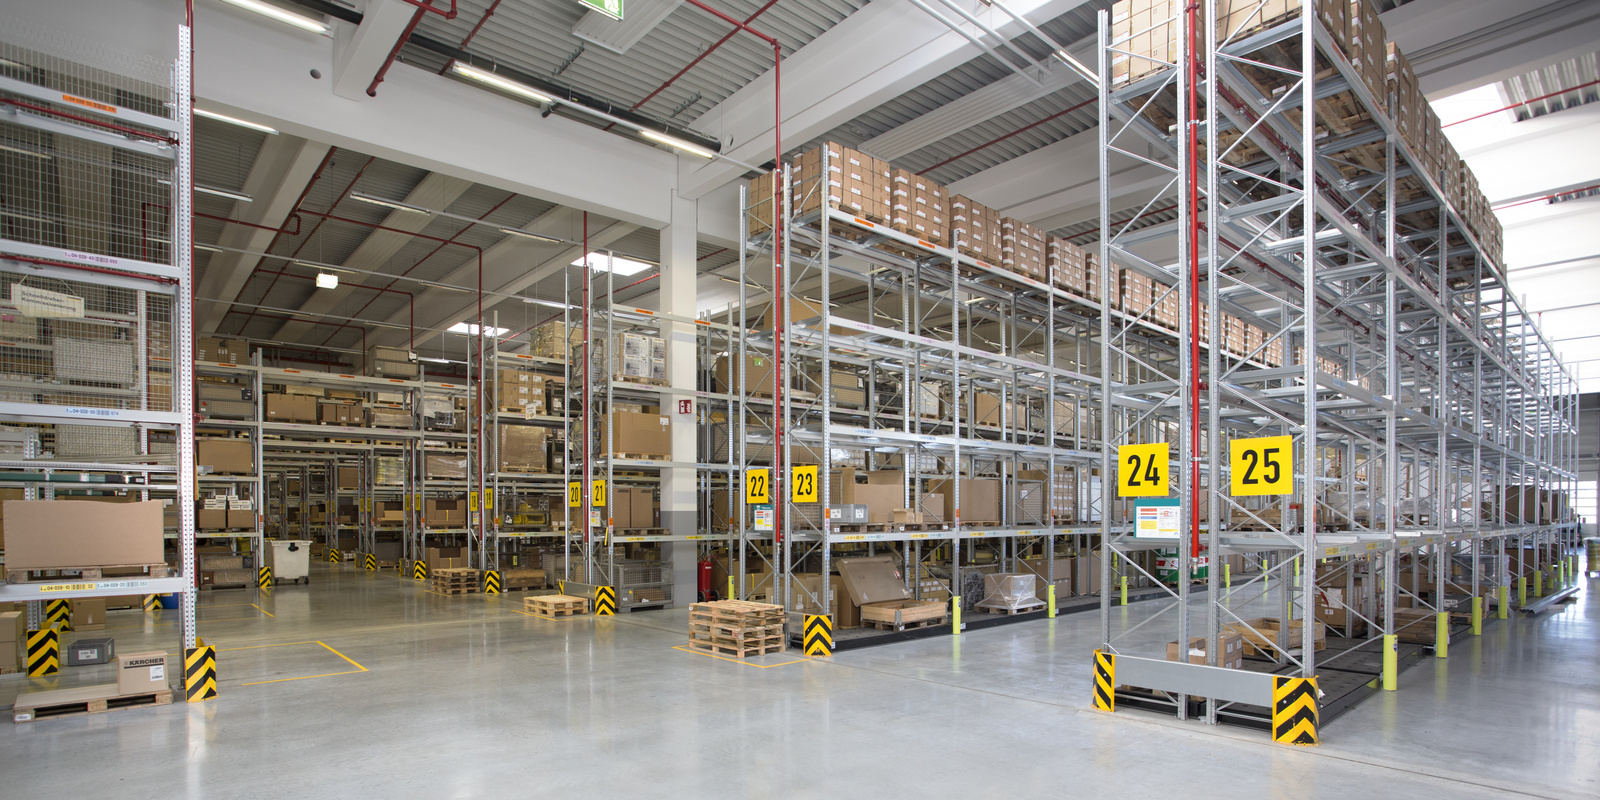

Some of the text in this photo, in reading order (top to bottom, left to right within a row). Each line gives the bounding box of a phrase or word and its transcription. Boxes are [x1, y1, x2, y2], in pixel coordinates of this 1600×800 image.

[1128, 454, 1160, 486] 24
[1242, 448, 1280, 484] 25
[594, 485, 602, 501] 21
[750, 476, 764, 496] 22
[797, 473, 812, 496] 23
[486, 492, 491, 505] 19
[570, 486, 578, 502] 20
[129, 658, 164, 666] KÄRCHER
